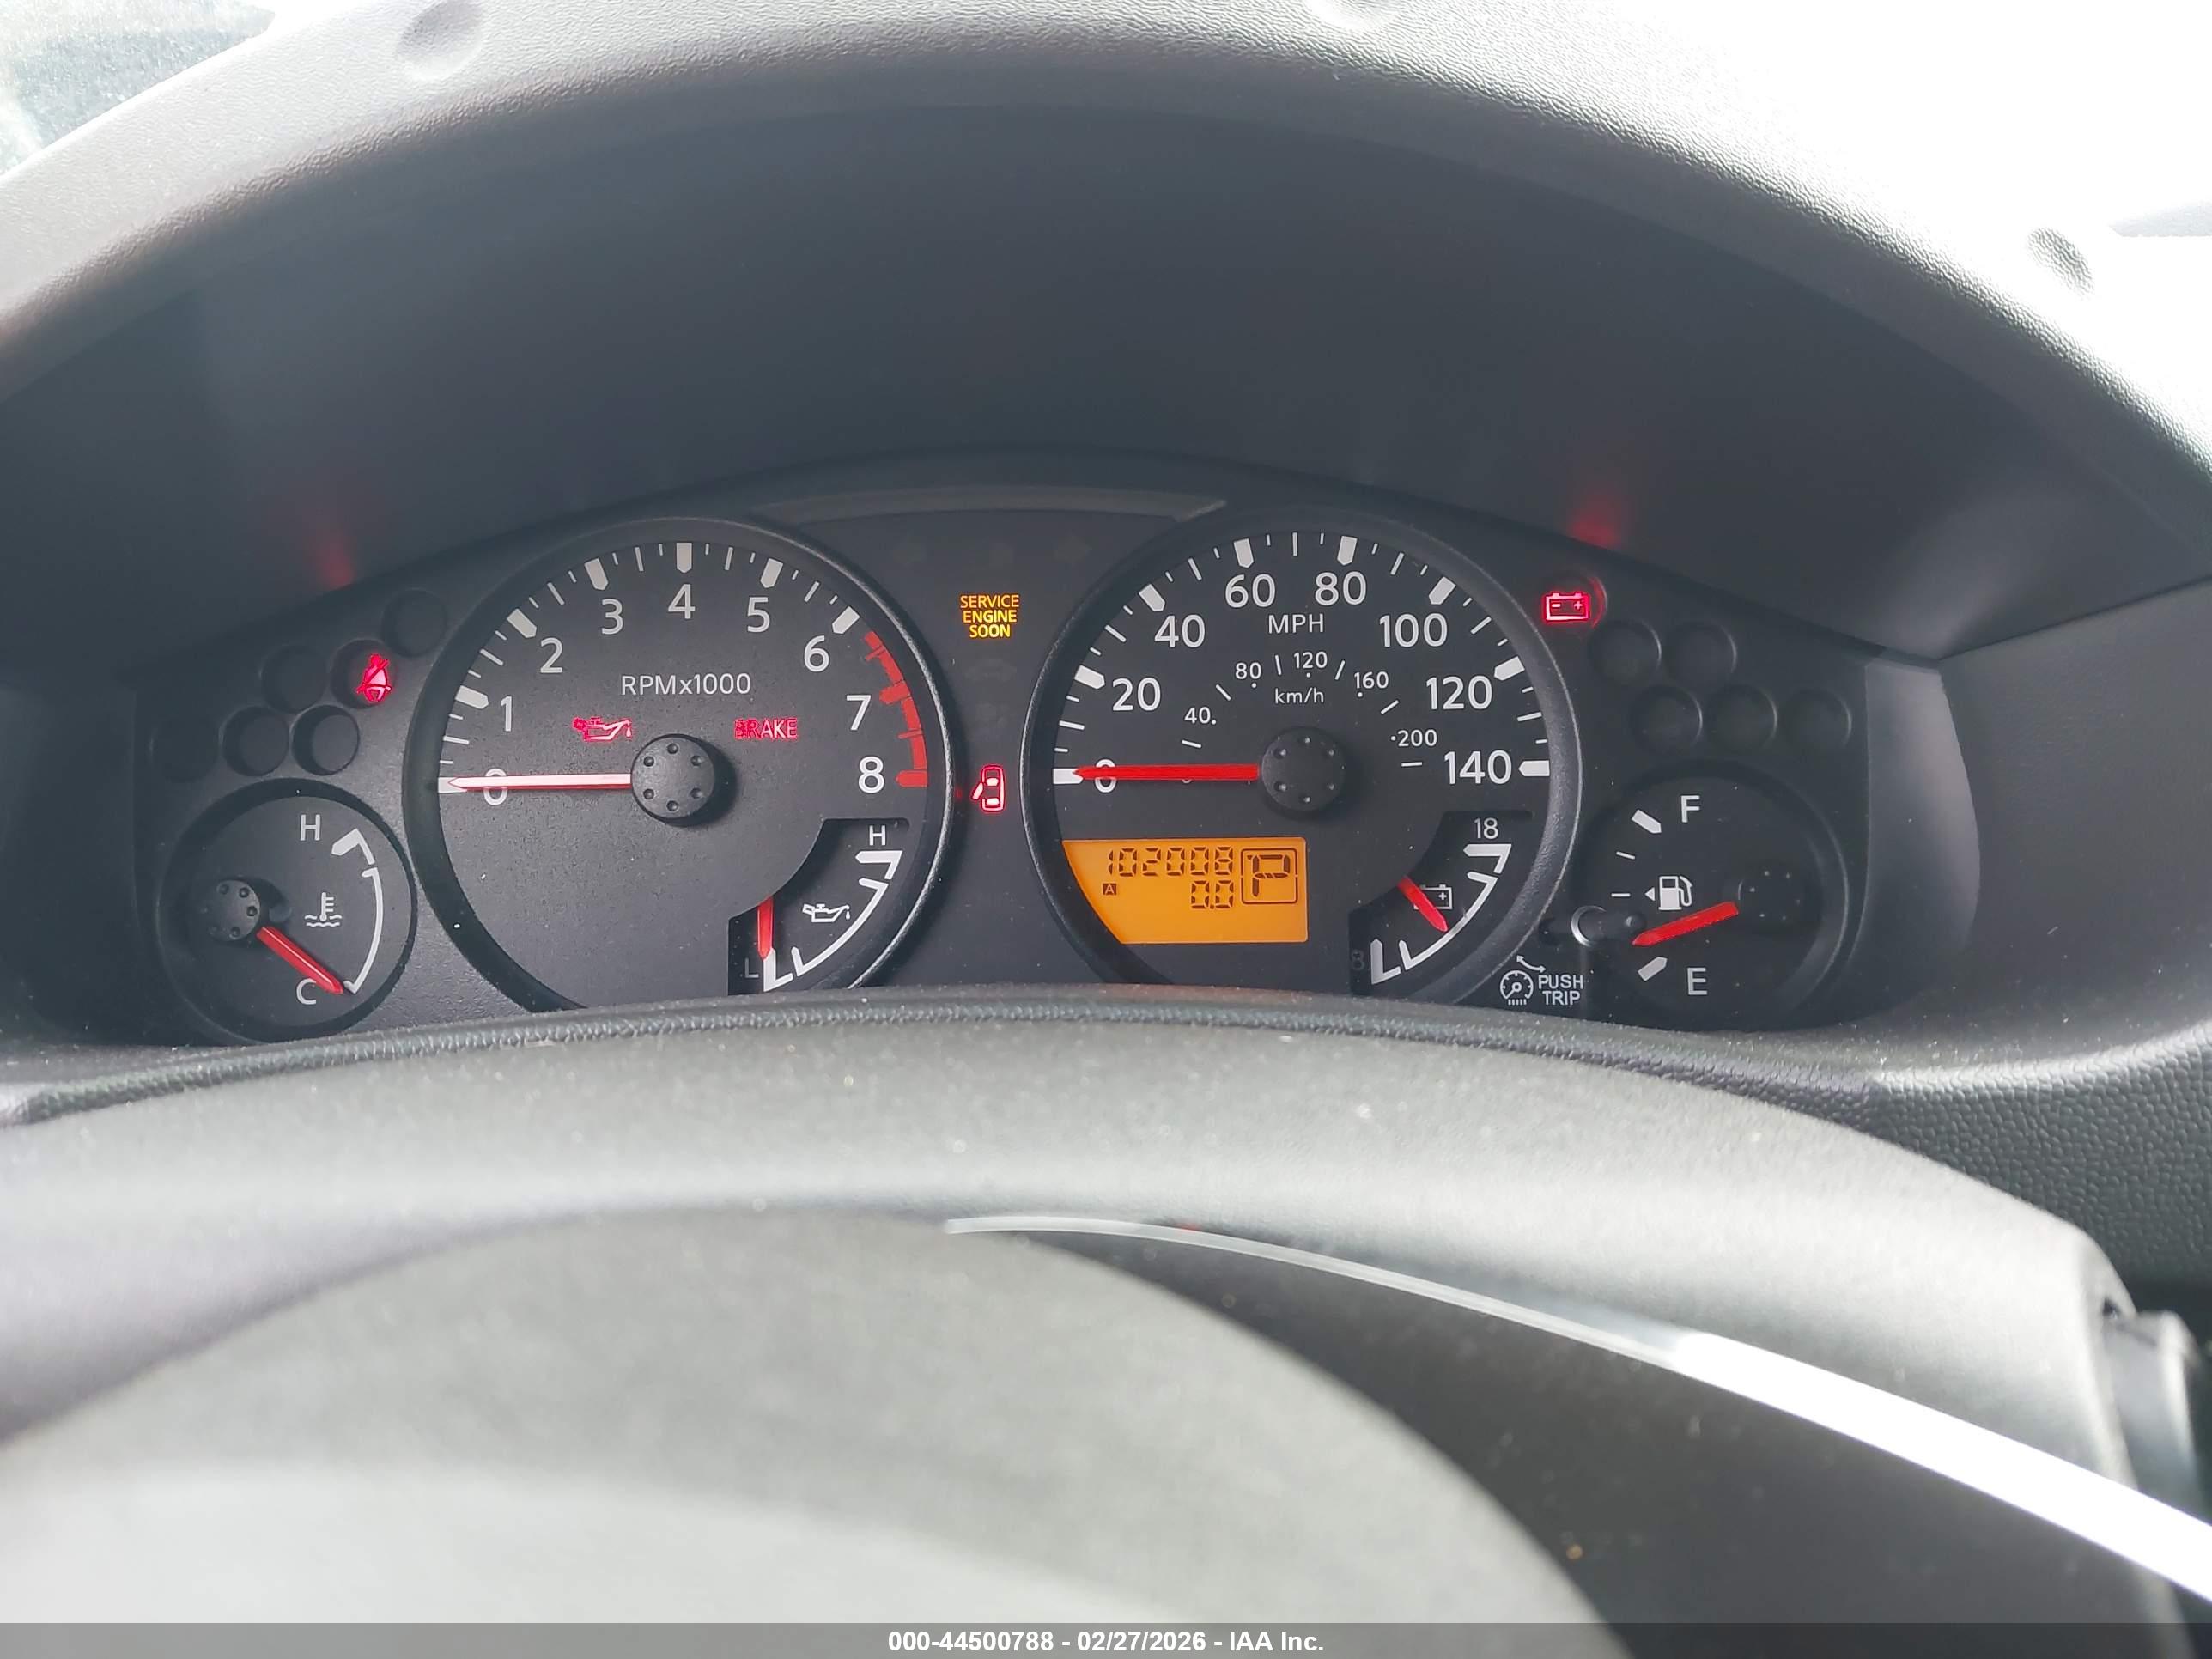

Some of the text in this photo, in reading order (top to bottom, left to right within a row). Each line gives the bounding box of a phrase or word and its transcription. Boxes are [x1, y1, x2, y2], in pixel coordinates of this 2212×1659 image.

[667, 584, 696, 619] 4
[960, 594, 1020, 609] SERVICE
[1225, 574, 1276, 608] 60
[1316, 572, 1366, 606] 80
[601, 598, 624, 635] 3
[747, 597, 770, 633] 5
[963, 609, 1018, 623] ENGINE
[1268, 614, 1324, 634] MPH
[969, 623, 1011, 638] SOON
[1154, 613, 1206, 648] 40
[1379, 613, 1448, 647] 100
[540, 637, 564, 674] 2
[804, 635, 830, 672] 6
[1294, 651, 1328, 670] 120
[622, 673, 751, 696] RPMx1000
[1235, 662, 1262, 680] 80
[1354, 671, 1389, 690] 160
[1112, 678, 1162, 712] 20
[1275, 687, 1324, 704] km/h
[1426, 676, 1493, 711] 120
[501, 696, 513, 732] 1
[847, 695, 872, 731] 7
[1184, 706, 1211, 724] 40
[733, 718, 798, 739] BRAKE
[1396, 729, 1437, 748] 200
[859, 756, 884, 793] 8
[1444, 750, 1512, 785] 140
[483, 768, 508, 805] 0
[1680, 795, 1700, 823] F
[300, 814, 321, 842] H
[869, 825, 886, 846] H
[1474, 817, 1499, 840] 18
[1108, 846, 1234, 877] 102008
[1247, 854, 1291, 897] P
[1190, 879, 1235, 909] 0.0
[744, 957, 759, 978] L
[1686, 967, 1708, 995] E
[295, 978, 317, 1006] C
[1538, 974, 1584, 990] PUSH
[1541, 990, 1581, 1006] TRIP
